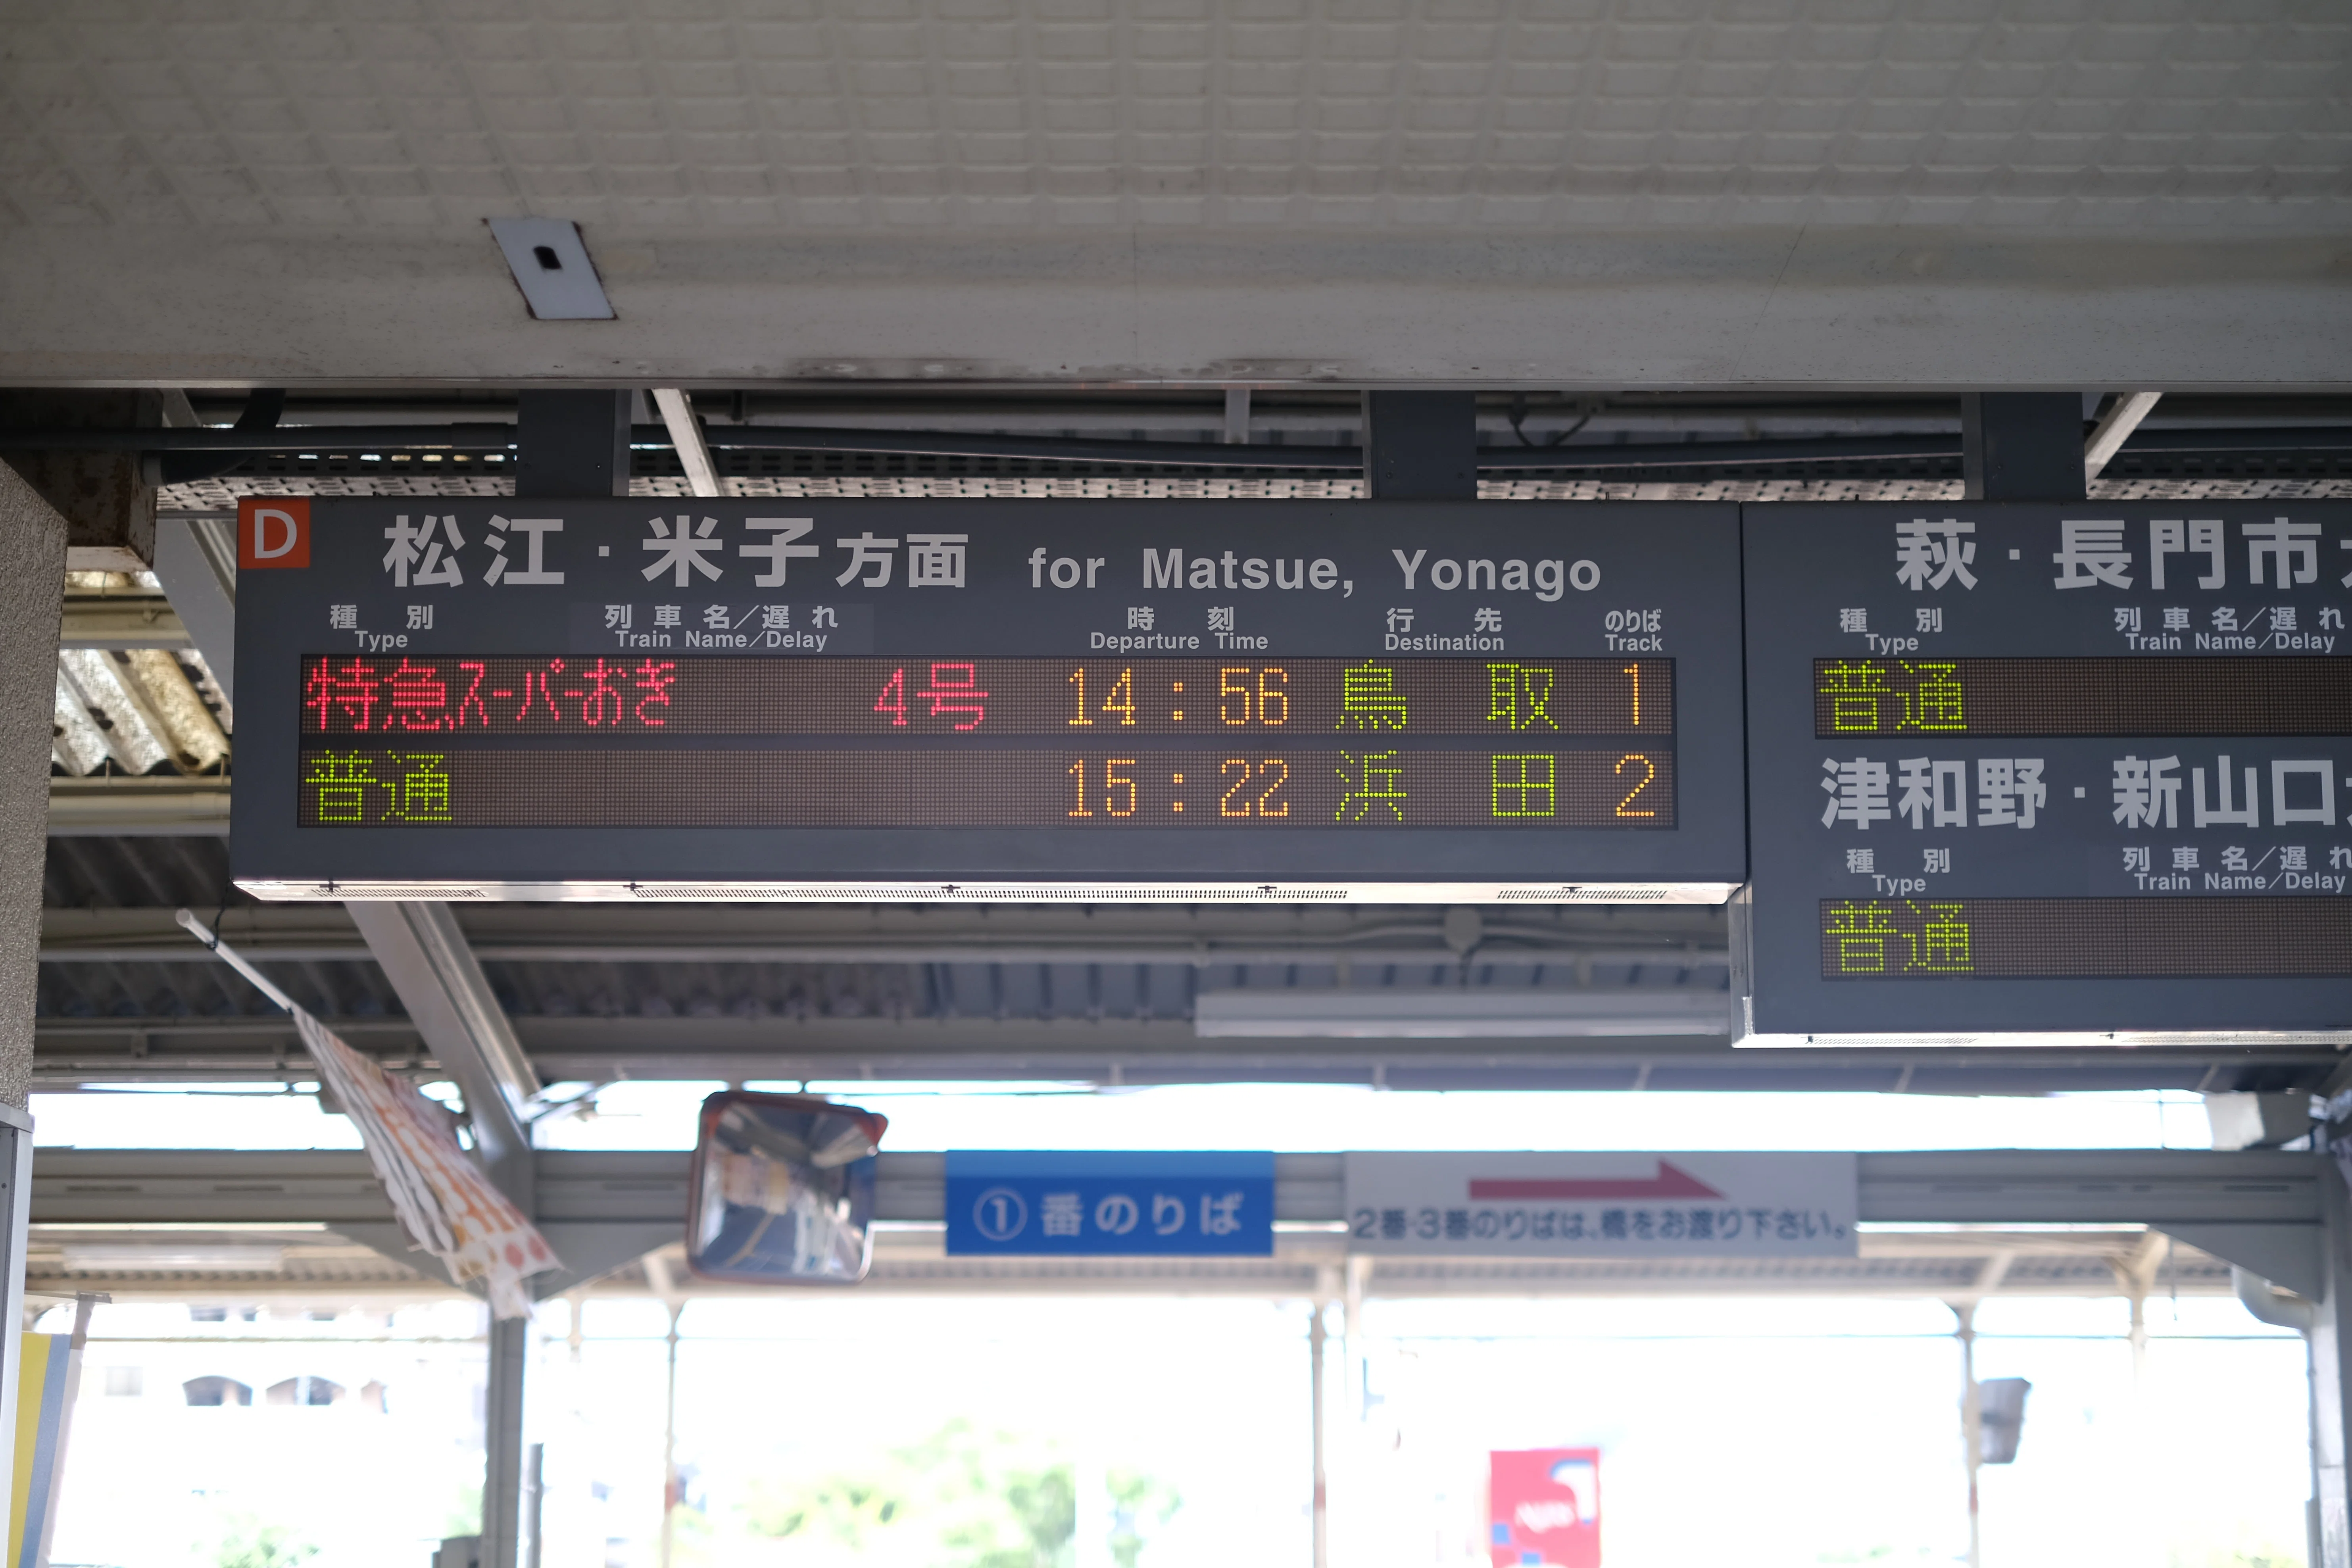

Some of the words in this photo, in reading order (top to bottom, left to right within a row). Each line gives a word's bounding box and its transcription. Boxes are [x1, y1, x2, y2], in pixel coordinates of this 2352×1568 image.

[254, 509, 297, 559] D
[1897, 518, 2352, 590] 萩・長門市
[1029, 548, 1104, 588] for
[1144, 549, 1353, 598] Matsue,
[1393, 550, 1600, 601] Yonago
[1606, 609, 1661, 632] のりば
[355, 631, 407, 651] Type
[615, 630, 671, 647] Train
[1091, 629, 1199, 653] Departure
[1215, 630, 1268, 649] Time
[1386, 634, 1504, 650] Destination
[1605, 634, 1662, 651] Track
[1866, 634, 1918, 655] Type
[2126, 633, 2181, 649] Train
[874, 664, 988, 730] 4号
[1070, 669, 1287, 724] 14:56
[1336, 660, 1558, 729] 鳥取
[1624, 664, 1639, 724] 1
[1821, 661, 1966, 730] 普通
[306, 750, 452, 820] 普通
[1070, 760, 1287, 816] 15:22
[1336, 751, 1554, 820] 浜田
[1616, 755, 1654, 816] 2
[1821, 756, 2352, 829] 津和野・新山口
[1872, 875, 1925, 896] Type
[2135, 873, 2190, 890] Train
[1826, 900, 1974, 971] 普通
